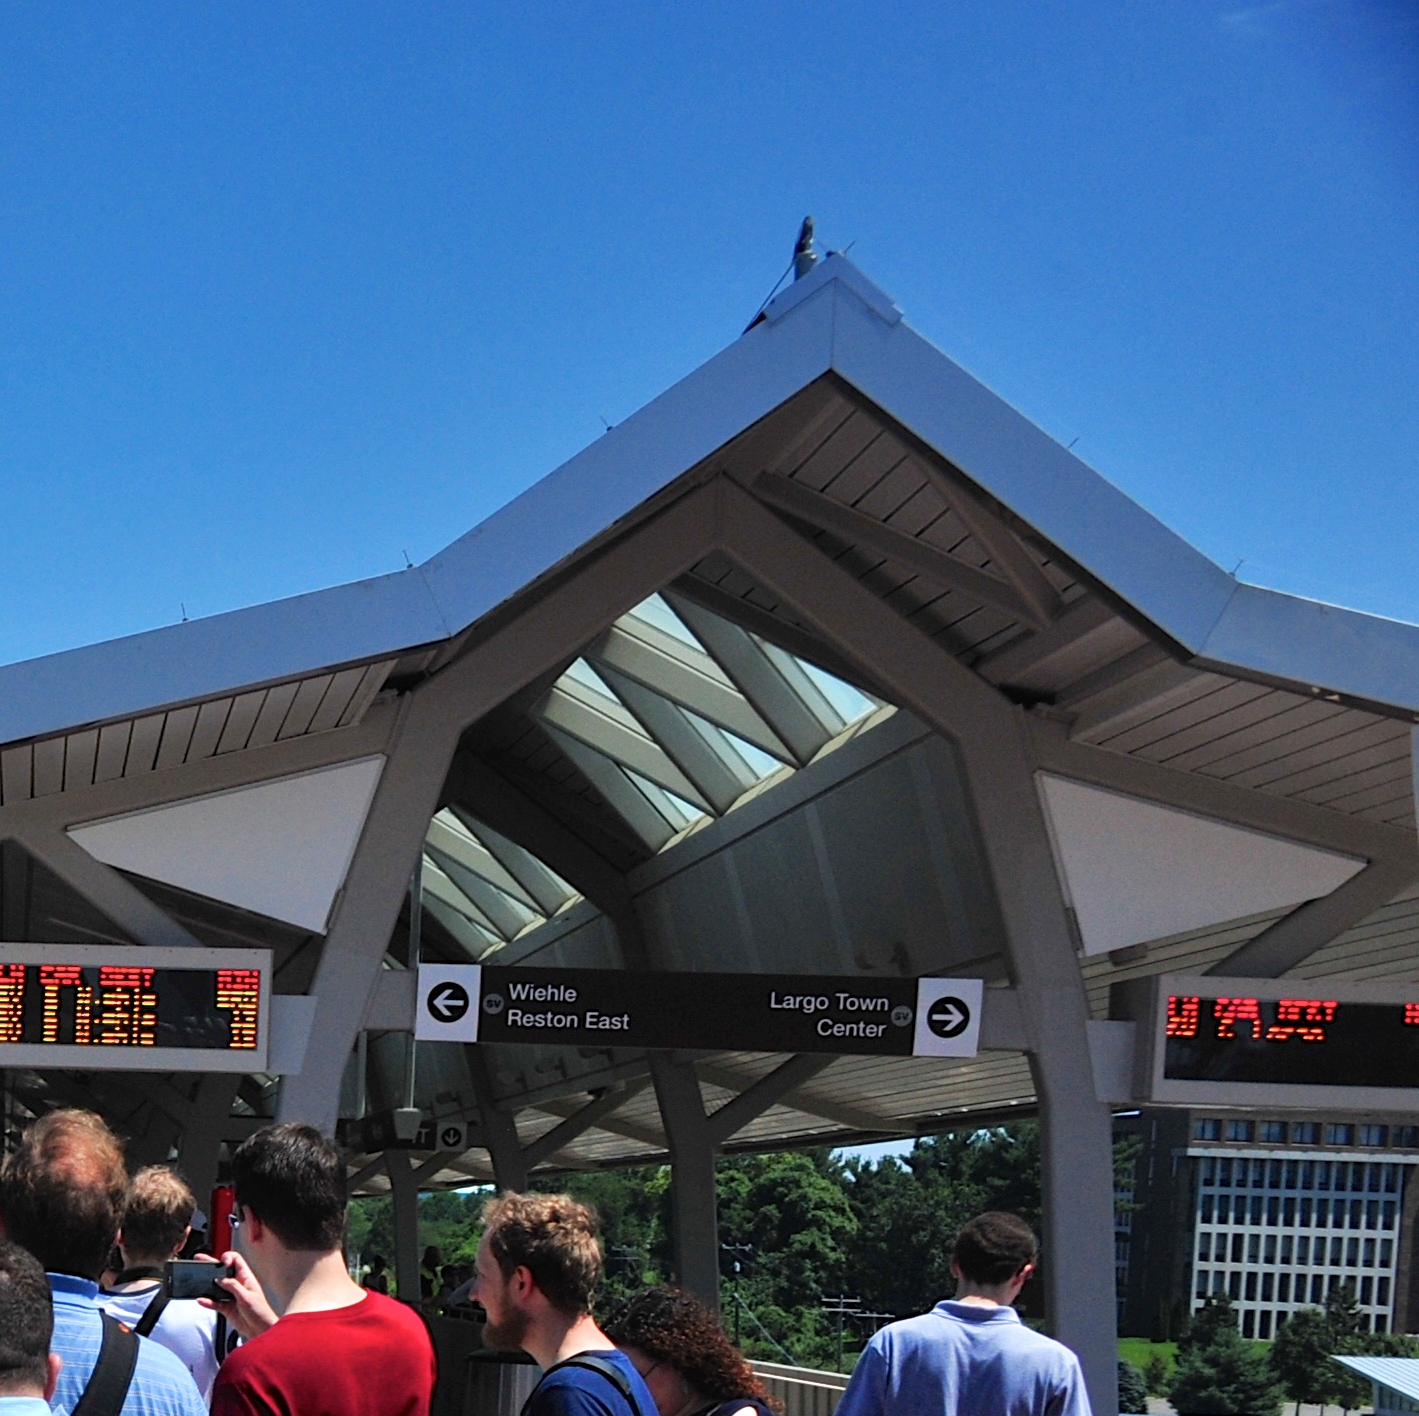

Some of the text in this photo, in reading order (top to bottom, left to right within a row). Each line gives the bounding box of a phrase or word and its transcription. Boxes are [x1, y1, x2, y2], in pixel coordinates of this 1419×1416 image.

[509, 983, 577, 1002] Wiehle
[486, 999, 502, 1009] SV
[770, 992, 889, 1014] Largo Town
[507, 1009, 629, 1030] Reston East
[894, 1011, 909, 1021] SV
[817, 1019, 886, 1037] Center
